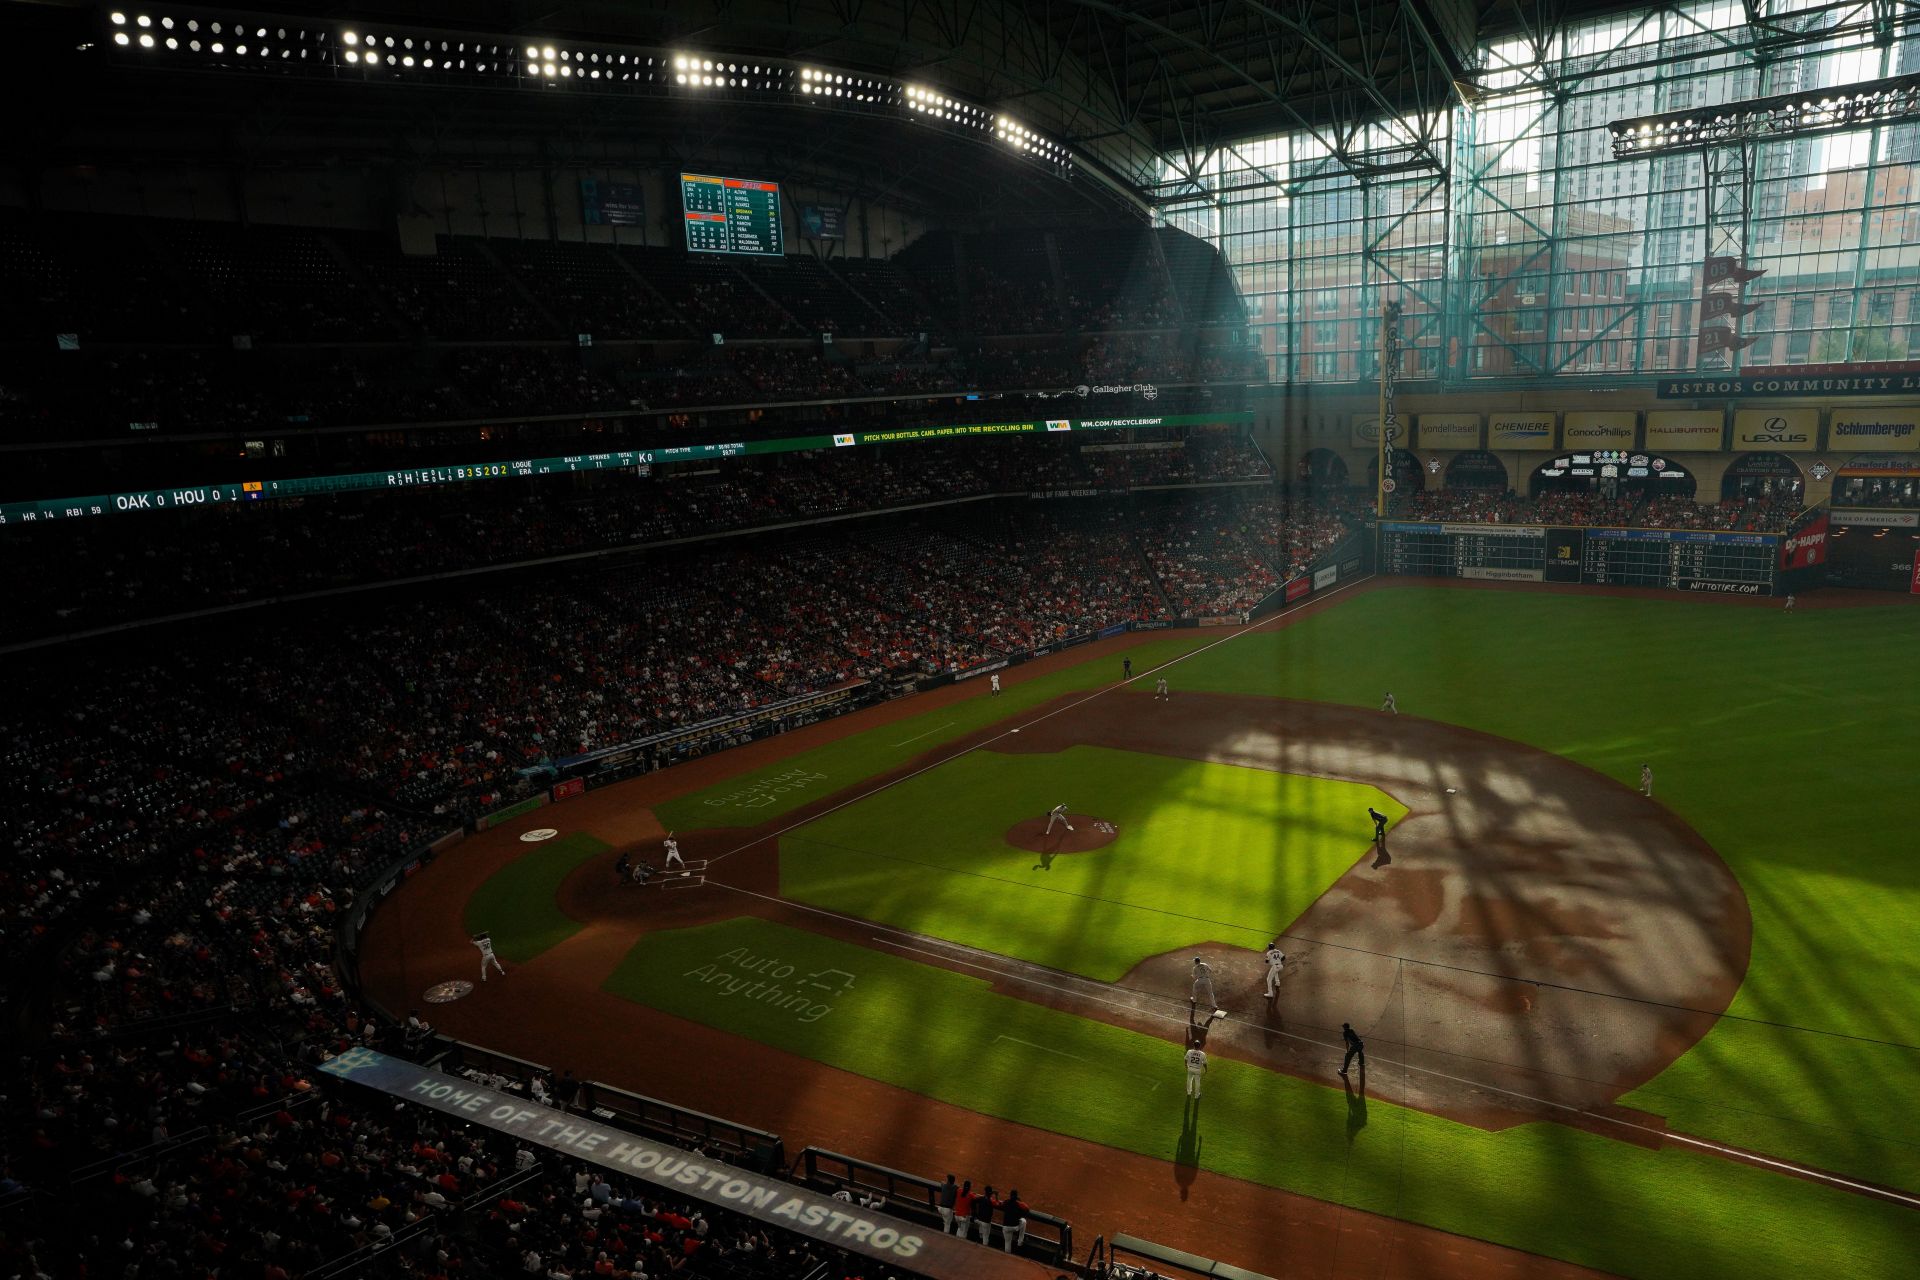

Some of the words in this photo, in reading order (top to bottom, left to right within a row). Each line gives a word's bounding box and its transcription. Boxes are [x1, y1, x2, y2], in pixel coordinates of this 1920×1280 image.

[1711, 262, 1728, 277] 05
[1710, 298, 1724, 312] 19
[1705, 332, 1719, 344] 21
[1092, 385, 1132, 396] Gallagher
[1134, 384, 1154, 392] Club
[1669, 382, 1743, 394] ASTROS
[1752, 378, 1891, 392] COMMUNITY
[1080, 418, 1162, 428] WM.COM/RECYCLERIGHT
[1494, 422, 1550, 431] CHENIERE
[1836, 422, 1916, 438] Schlumberger
[1567, 428, 1632, 438] ConocoPhillips
[1742, 434, 1808, 442] LEXUS
[639, 453, 646, 462] K
[1385, 430, 1394, 476] FAIR
[512, 460, 532, 469] LOGUE
[388, 475, 396, 485] R
[405, 474, 413, 483] H
[422, 472, 429, 482] E
[438, 471, 445, 480] L
[458, 469, 465, 478] B
[467, 468, 472, 477] 3
[476, 468, 482, 476] S
[484, 467, 490, 475] 2
[501, 466, 506, 474] 2
[116, 494, 150, 510] OAK
[157, 495, 165, 506] 0
[173, 489, 205, 505] HOU
[212, 490, 220, 501] 0
[23, 512, 36, 521] HR
[44, 511, 54, 519] 14
[66, 508, 83, 518] RBI
[92, 506, 101, 515] 59
[1486, 570, 1533, 579] Higginbotham
[1690, 582, 1758, 594] NITTOTIRE.COM
[716, 947, 795, 978] Auto
[682, 963, 835, 1022] Anything
[410, 1078, 491, 1112] HOME
[489, 1104, 536, 1130] OF
[538, 1120, 609, 1152] THE
[606, 1142, 778, 1210] HOUSTON
[772, 1198, 924, 1257] ASTROS
